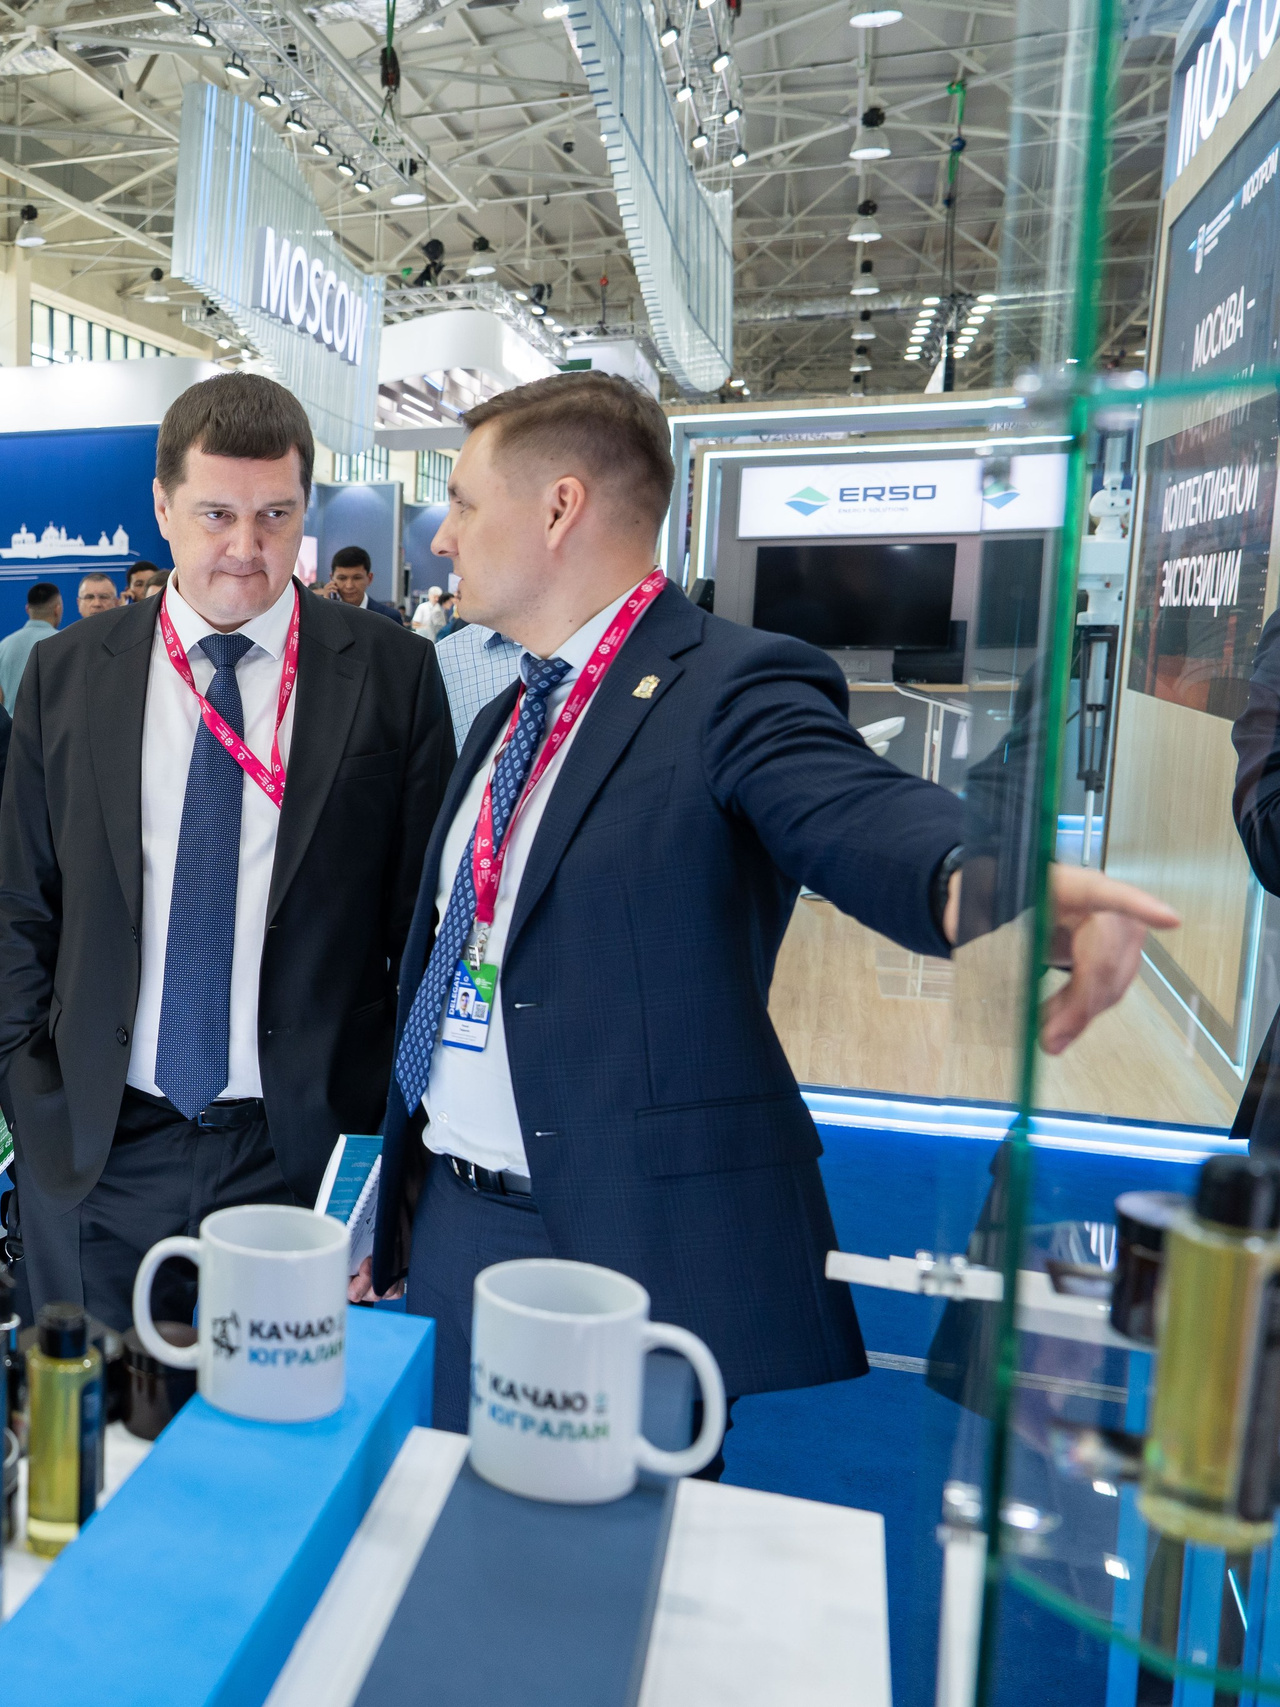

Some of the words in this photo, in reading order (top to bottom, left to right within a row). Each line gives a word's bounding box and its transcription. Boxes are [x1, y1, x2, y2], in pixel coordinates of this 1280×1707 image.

[260, 226, 368, 366] MOSCOW
[1191, 285, 1245, 372] МОСКВА
[839, 484, 937, 502] ERSO
[1161, 445, 1261, 533] КОЛЛЕКТИВНОЙ
[1159, 549, 1243, 618] ЭКСПОЗИЦИИ
[447, 970, 462, 1016] DELEGATE
[248, 1315, 334, 1341] КАЧАЮ
[488, 1373, 589, 1415] КАЧАЮ
